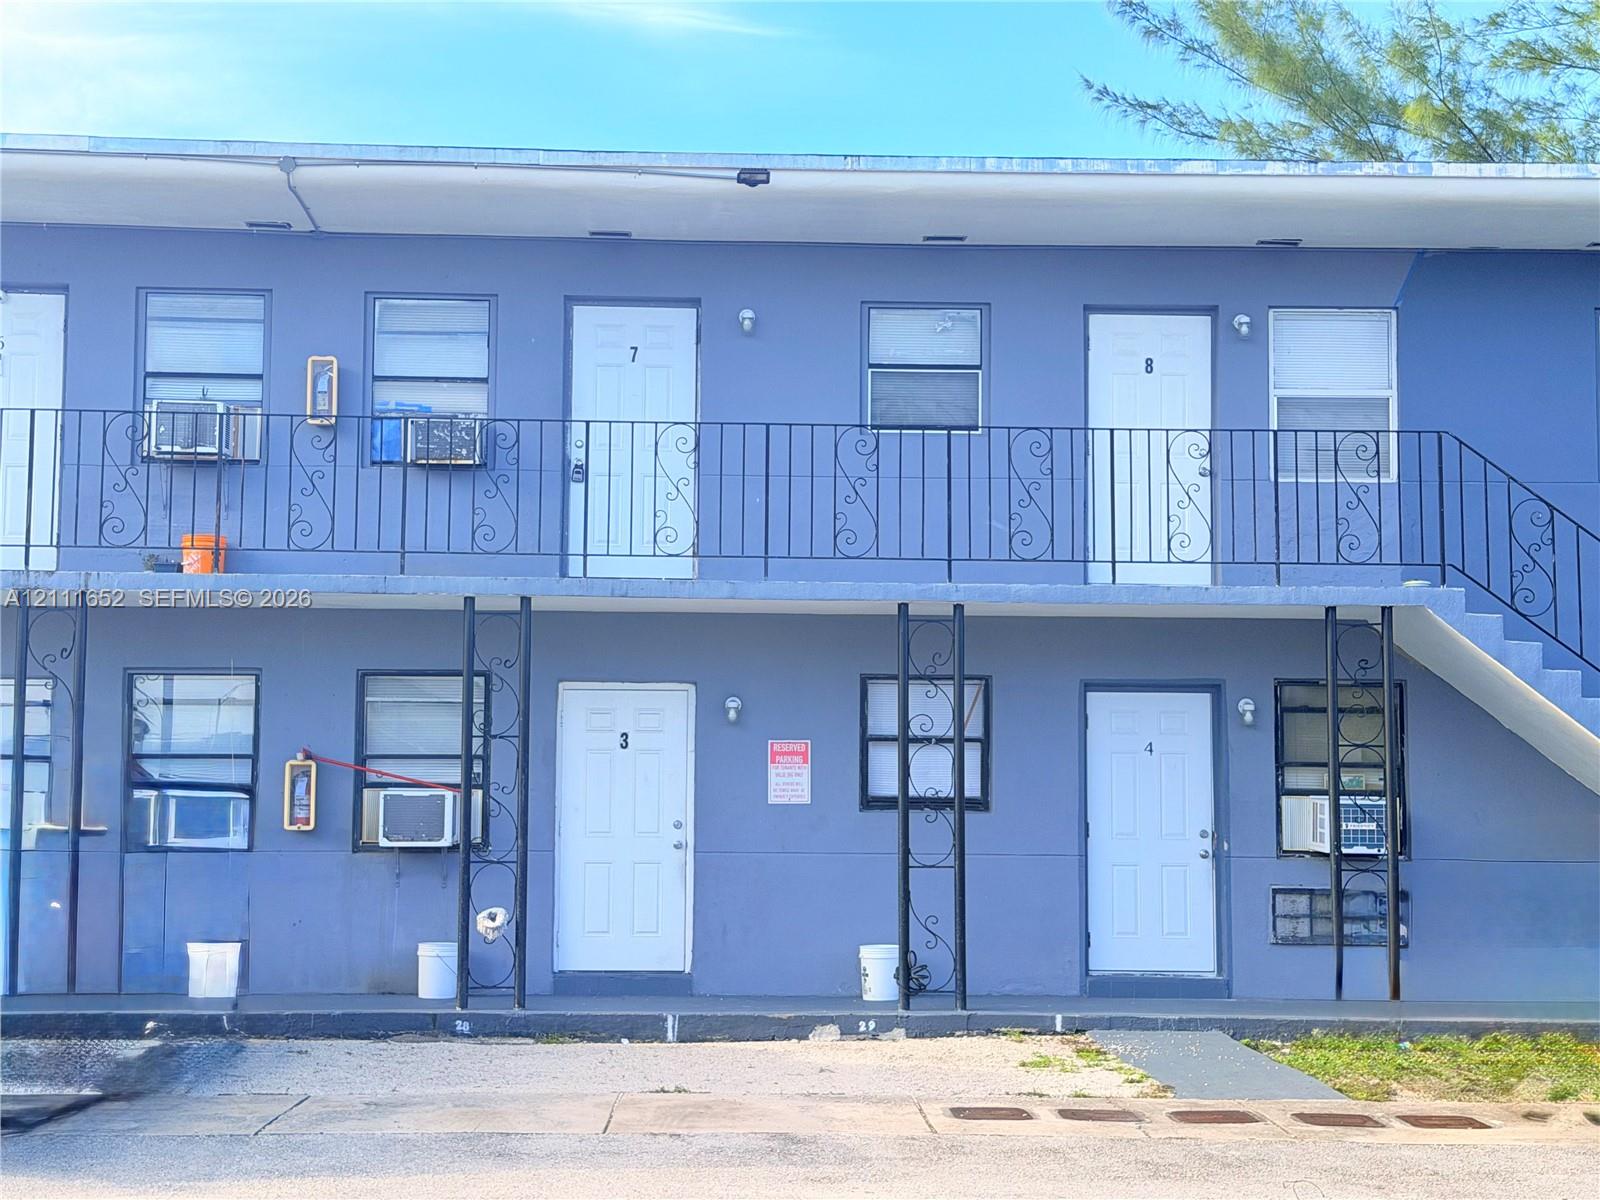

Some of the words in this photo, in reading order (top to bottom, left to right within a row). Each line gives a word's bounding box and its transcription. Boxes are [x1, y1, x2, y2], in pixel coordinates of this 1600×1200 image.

[630, 346, 638, 363] 7
[1145, 357, 1154, 374] 8
[620, 732, 629, 749] 3
[773, 743, 806, 752] RESERVED
[1144, 741, 1154, 756] 4
[775, 755, 804, 764] PARKING
[455, 1020, 470, 1031] 28
[858, 1020, 876, 1032] 29
